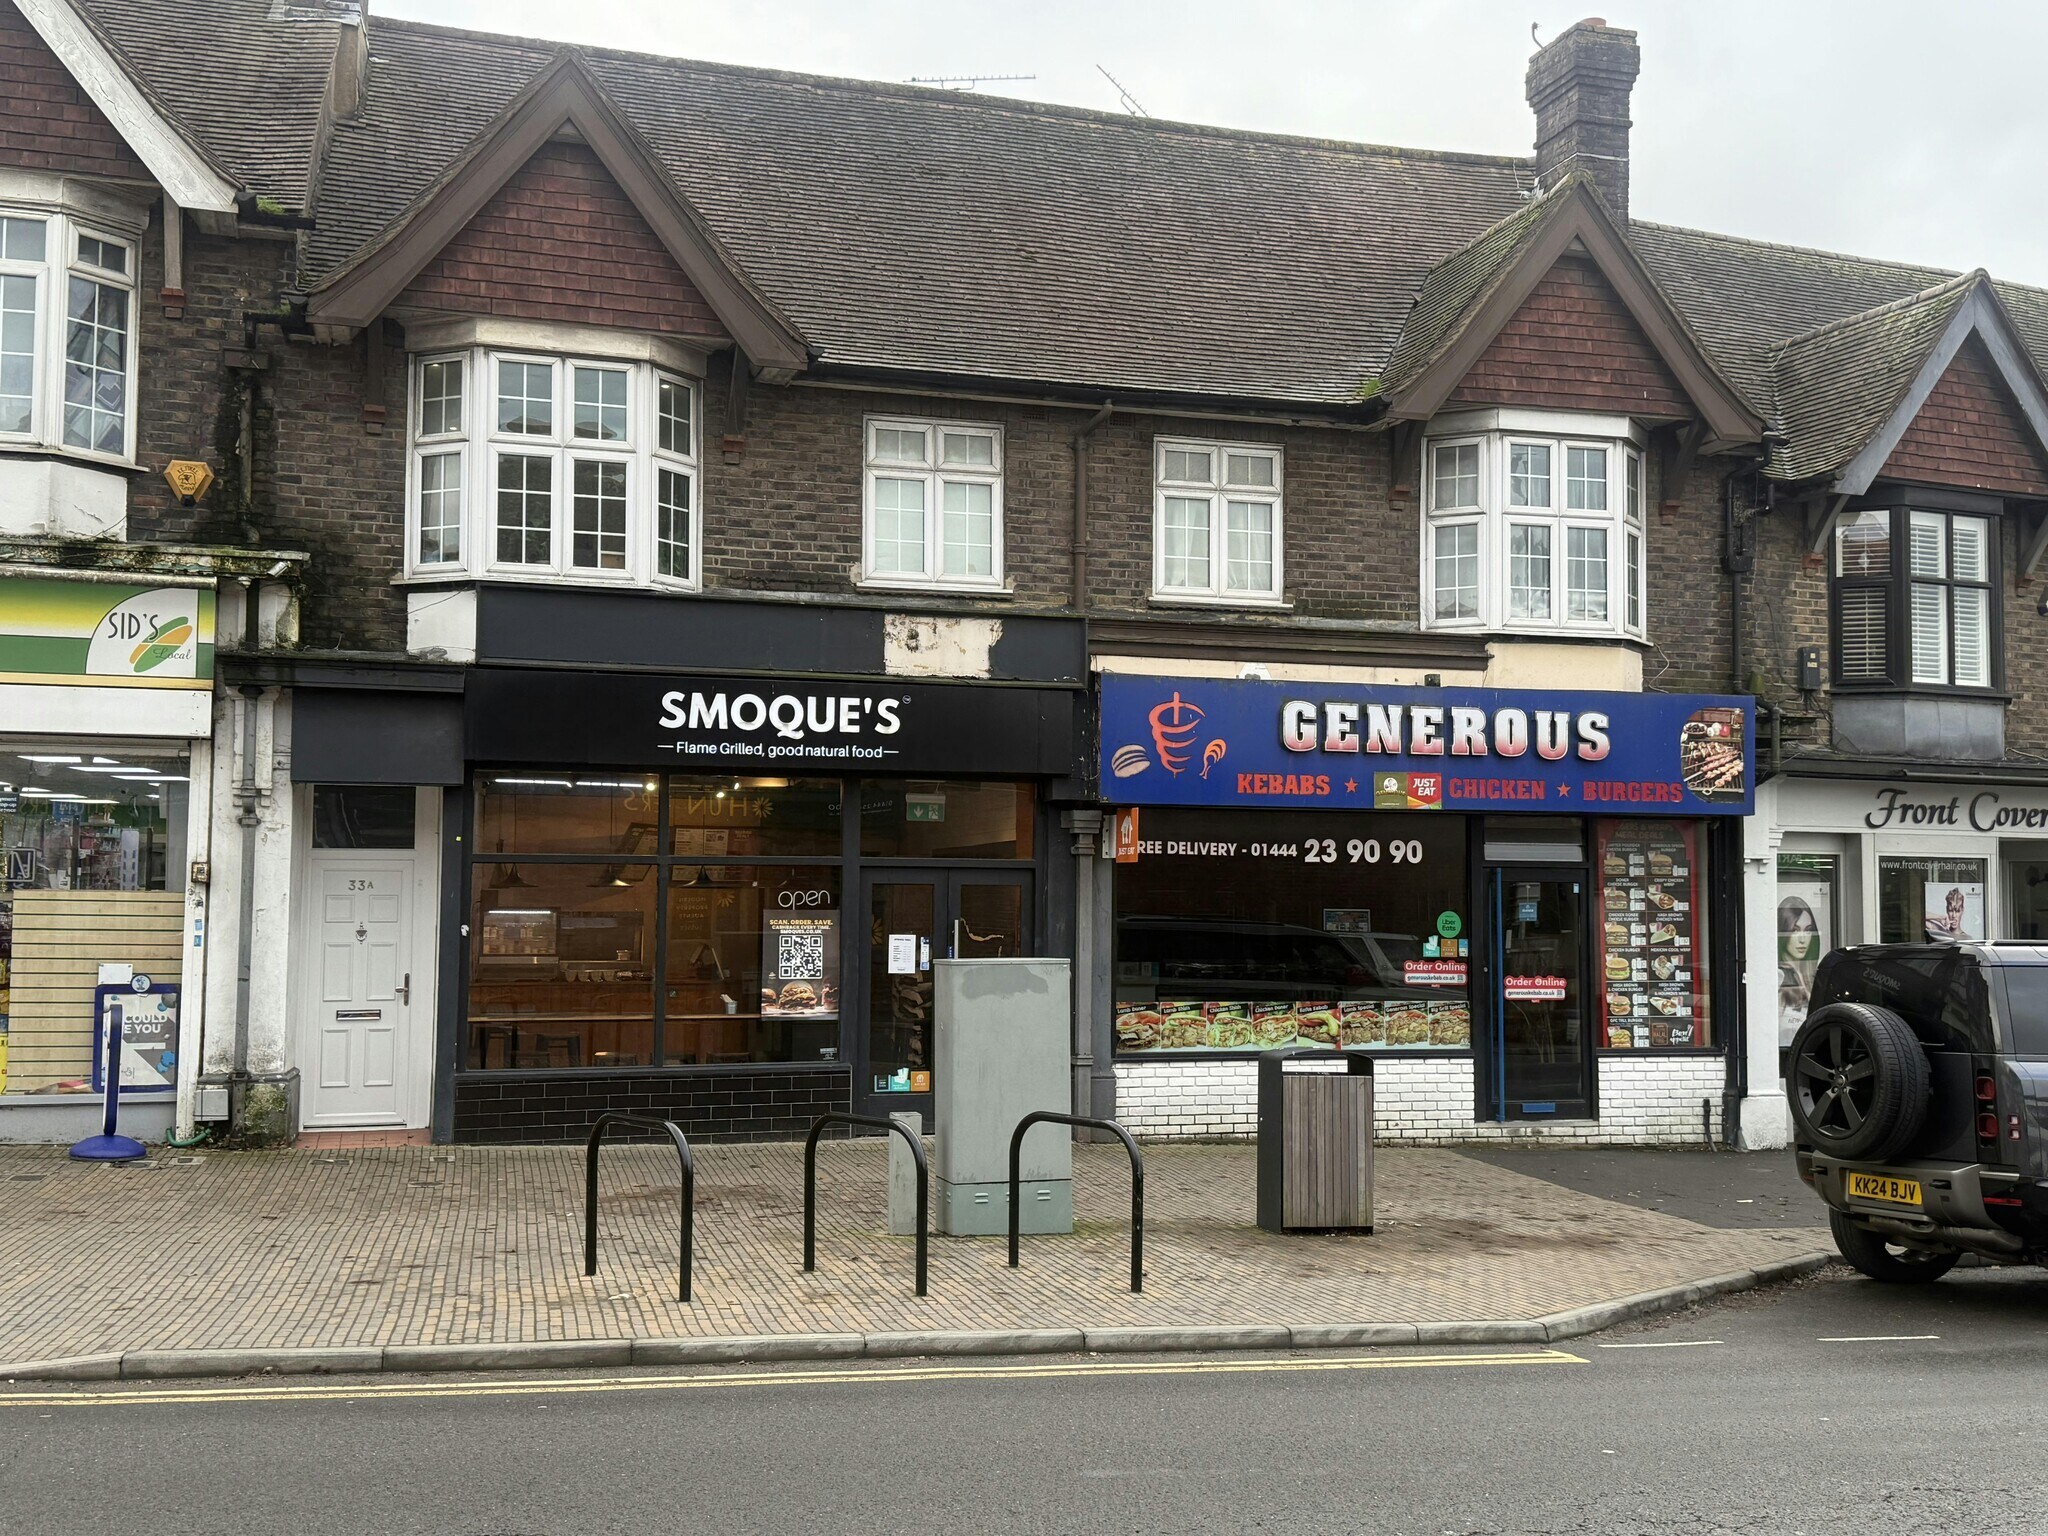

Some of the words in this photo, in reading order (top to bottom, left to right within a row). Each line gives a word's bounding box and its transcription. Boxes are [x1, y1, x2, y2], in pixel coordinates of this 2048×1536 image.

[108, 612, 158, 640] SID'S
[153, 648, 192, 660] Local
[659, 691, 901, 740] SMOQUE'S
[1281, 700, 1610, 761] GENEROUS
[676, 742, 717, 754] Flame
[720, 743, 765, 757] Grilled,
[768, 744, 804, 758] good
[806, 745, 849, 757] natural
[852, 746, 883, 758] food
[1237, 774, 1330, 795] KEBABS
[1412, 778, 1436, 788] JUST
[1450, 778, 1545, 800] CHICKEN
[1583, 780, 1684, 802] BURGERS
[1418, 788, 1436, 796] EAT
[1865, 788, 1960, 828] Front
[1969, 792, 2048, 832] Cover
[1118, 848, 1127, 856] JUST
[1138, 841, 1162, 854] REE
[1167, 841, 1237, 856] DELIVERY
[1251, 843, 1297, 856] 01444
[1304, 838, 1337, 863] 23
[1346, 839, 1380, 864] 90
[1389, 840, 1422, 864] 90
[1880, 860, 1978, 872] www.frontcoverhair.co.uk
[348, 880, 374, 890] 33A
[778, 890, 830, 910] open
[1435, 962, 1466, 970] Online
[1535, 978, 1565, 986] Online
[124, 1014, 168, 1023] COULD
[134, 1024, 160, 1034] YOU
[1855, 1177, 1886, 1196] KK24
[1891, 1182, 1916, 1200] BJV
